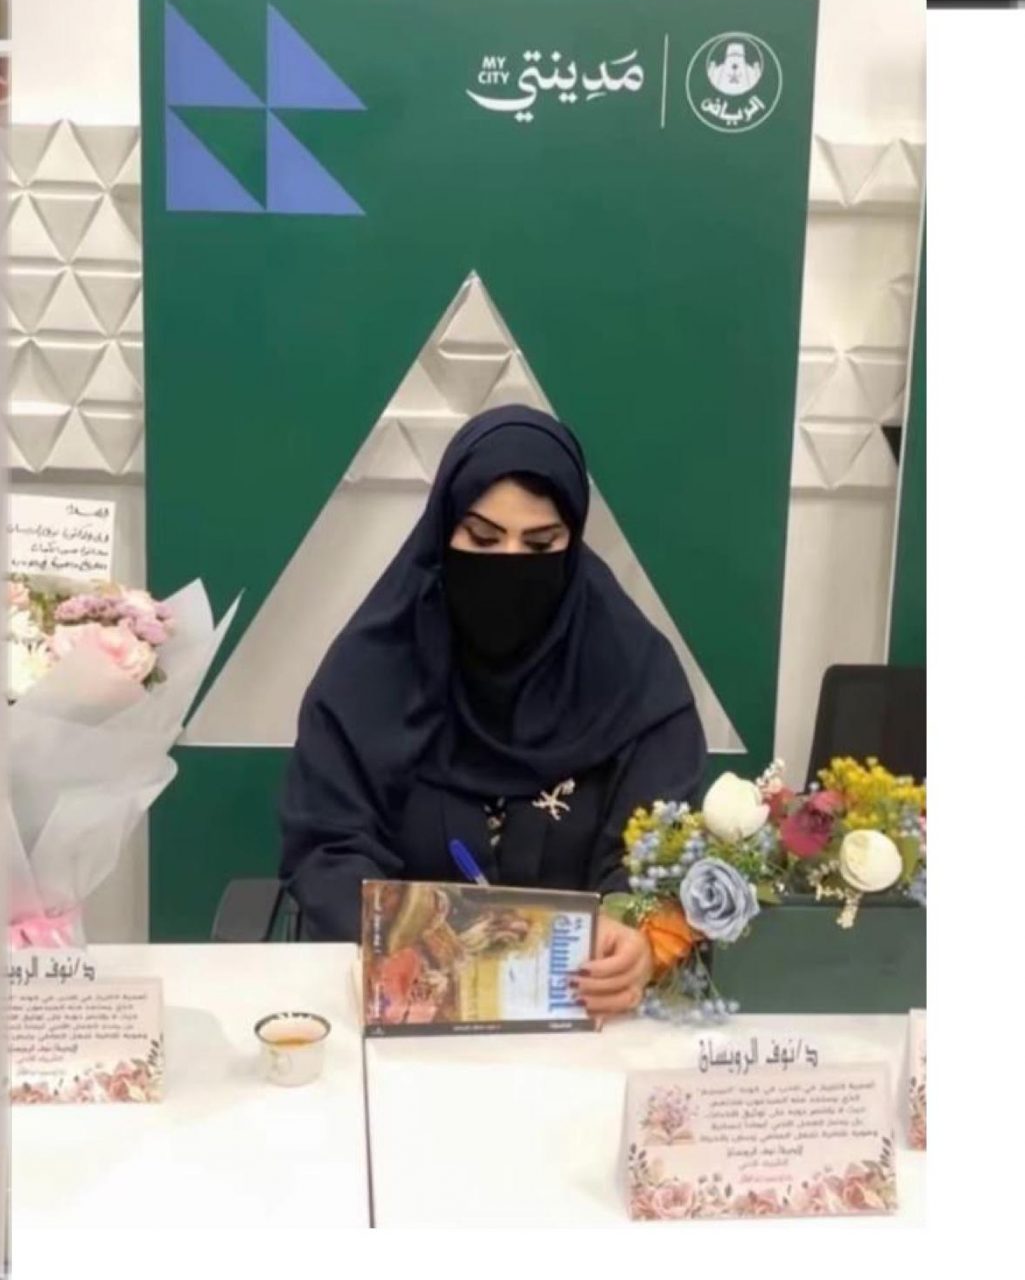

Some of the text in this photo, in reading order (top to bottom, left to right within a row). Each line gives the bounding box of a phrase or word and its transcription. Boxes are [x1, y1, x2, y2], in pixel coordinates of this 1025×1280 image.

[482, 57, 506, 68] MY
[478, 72, 510, 85] CITY
[701, 95, 765, 125] الرياض
